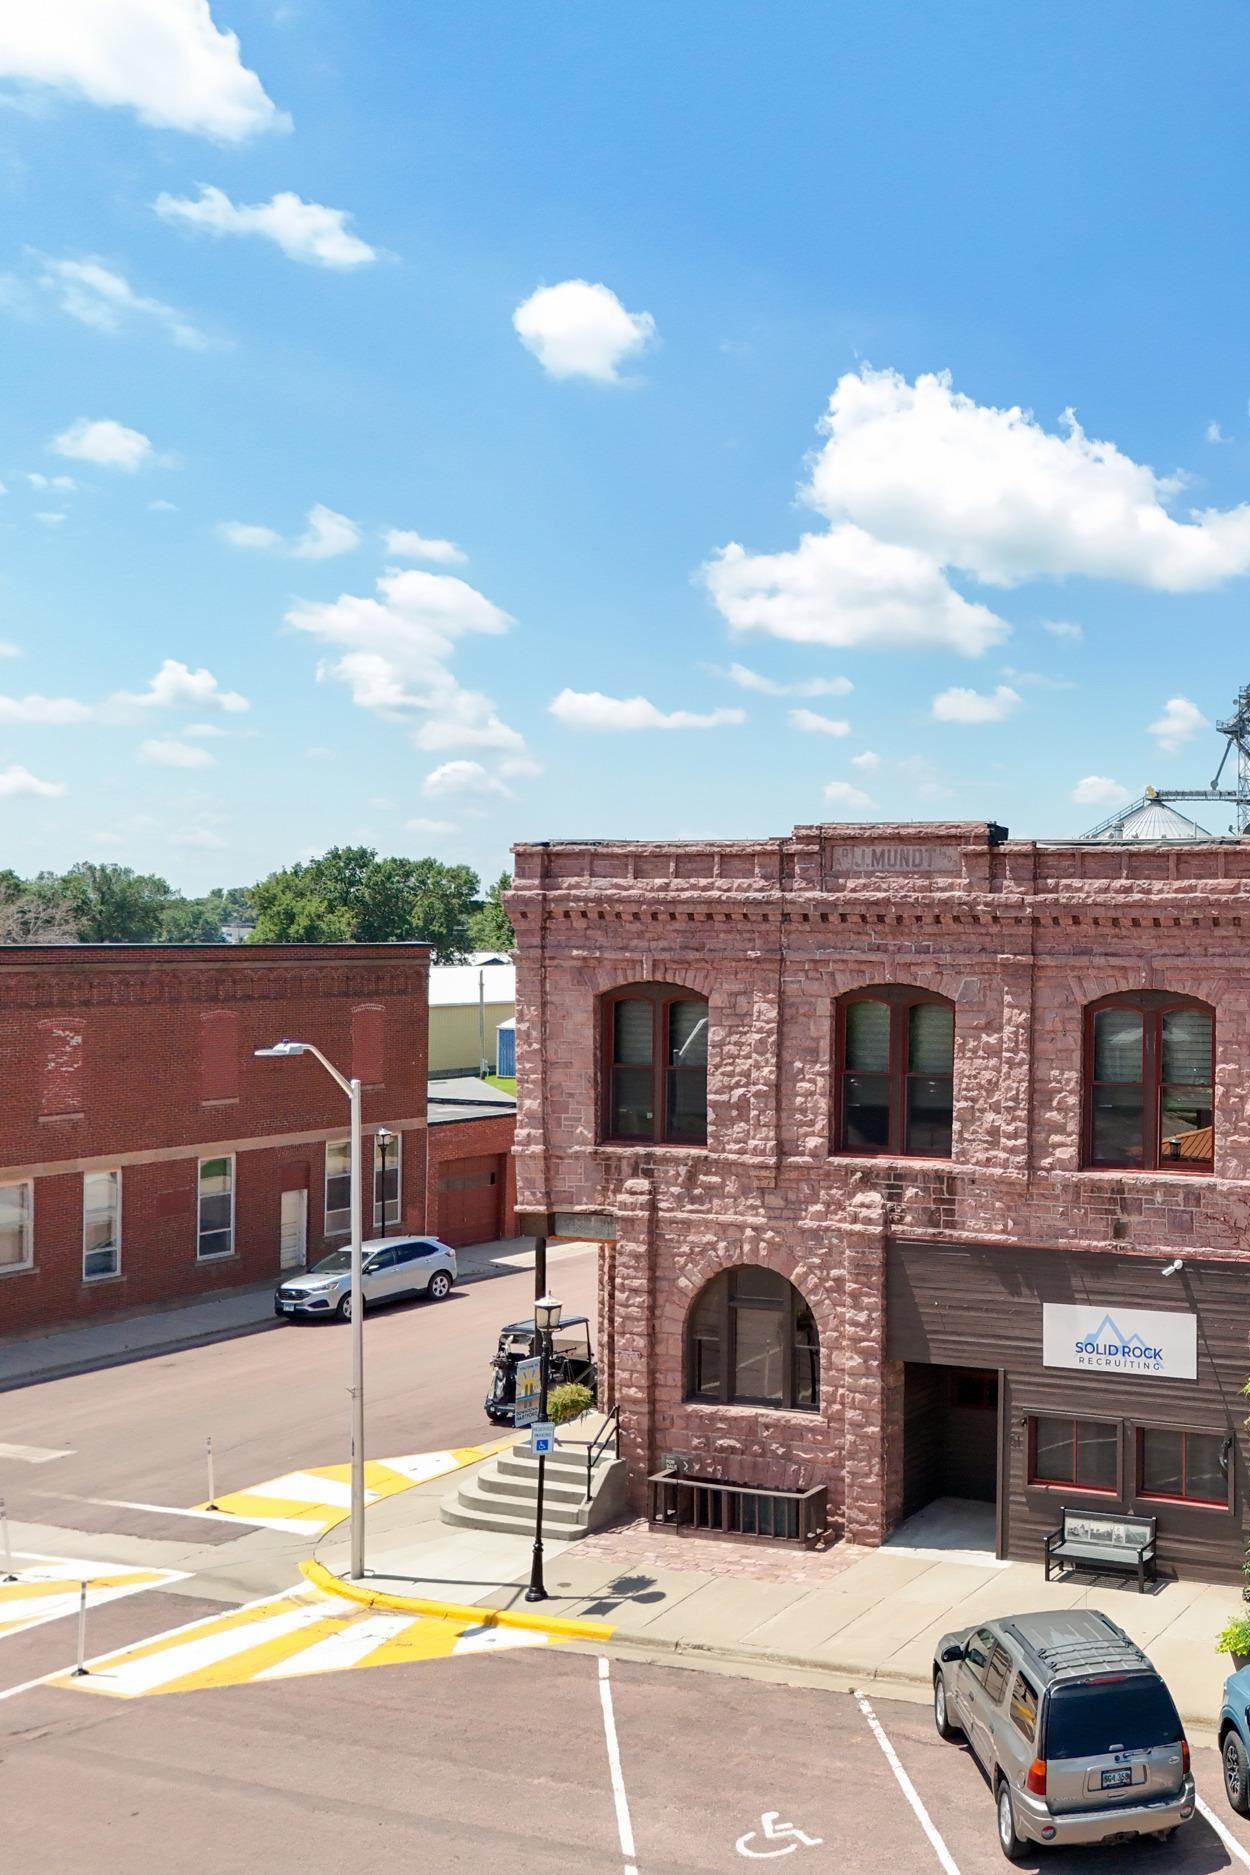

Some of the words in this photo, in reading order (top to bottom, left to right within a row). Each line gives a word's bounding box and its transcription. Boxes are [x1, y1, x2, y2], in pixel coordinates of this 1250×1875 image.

[1075, 1341, 1119, 1356] SOLID
[1122, 1345, 1164, 1361] ROCK
[1078, 1356, 1160, 1371] RECRUITING
